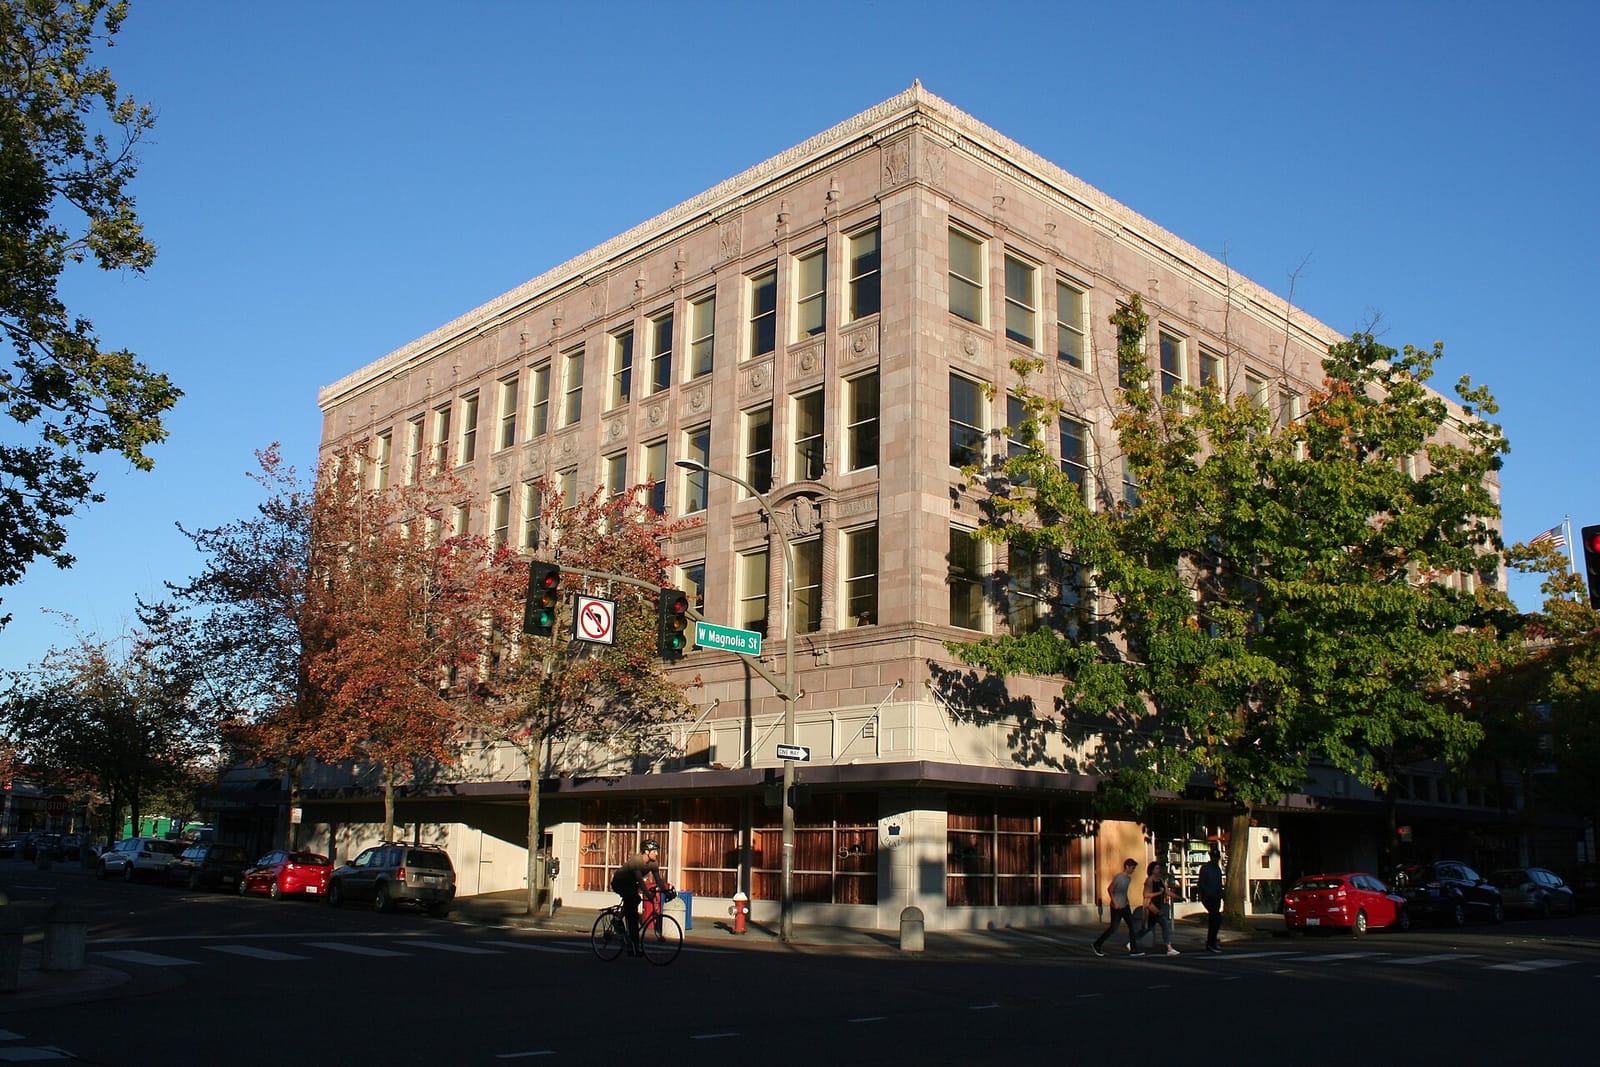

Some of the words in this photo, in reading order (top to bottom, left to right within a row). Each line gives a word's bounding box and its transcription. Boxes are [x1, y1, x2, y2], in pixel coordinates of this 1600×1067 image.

[698, 628, 706, 640] W
[708, 630, 745, 647] Magnolia
[748, 637, 758, 650] St
[47, 801, 67, 809] STOP
